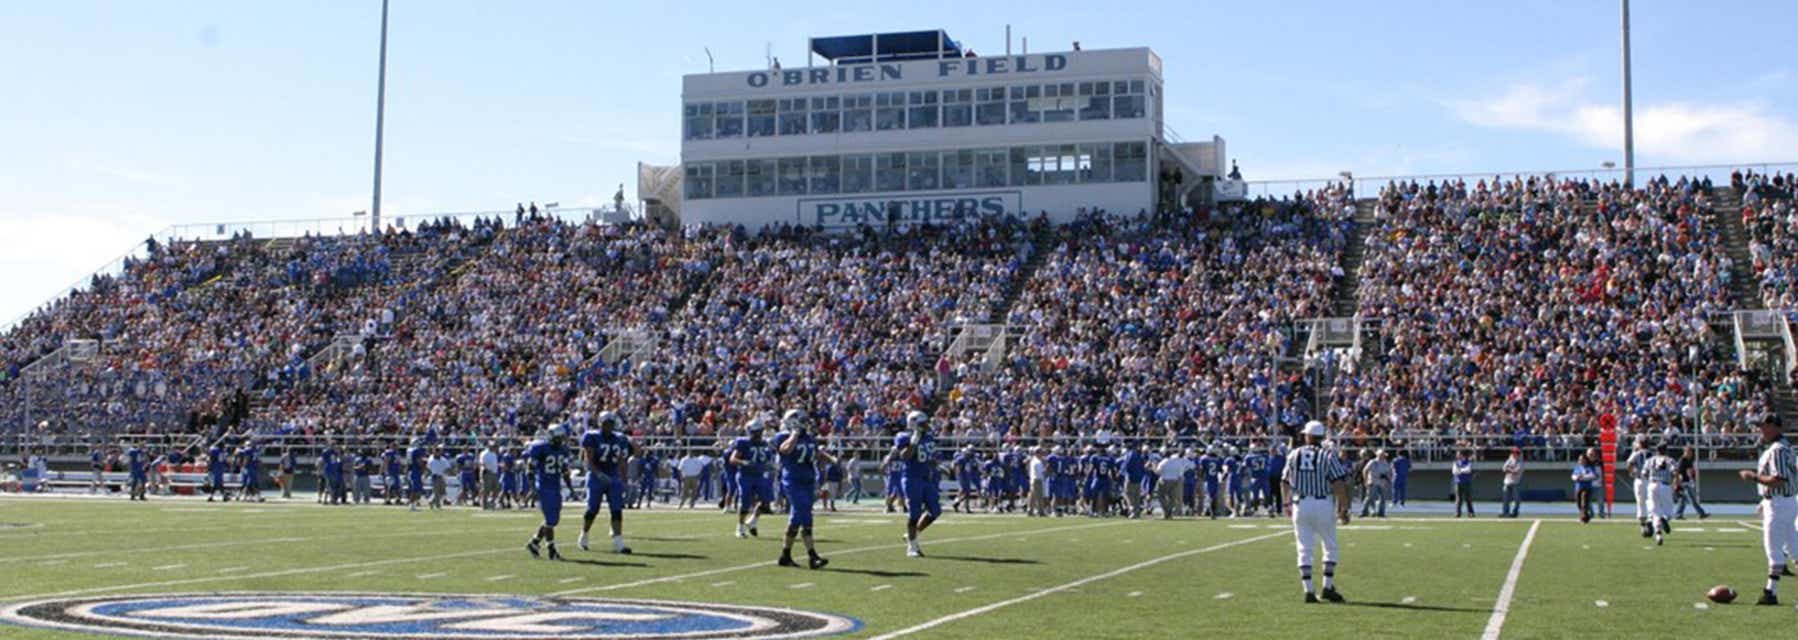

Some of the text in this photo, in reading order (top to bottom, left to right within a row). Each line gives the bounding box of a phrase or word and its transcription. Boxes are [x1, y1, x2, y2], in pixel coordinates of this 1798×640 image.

[747, 55, 1066, 87] O'BRIEN FIELD
[816, 196, 1004, 225] PANTHERS
[600, 444, 620, 462] 73
[750, 446, 767, 462] 75
[1301, 449, 1315, 470] R
